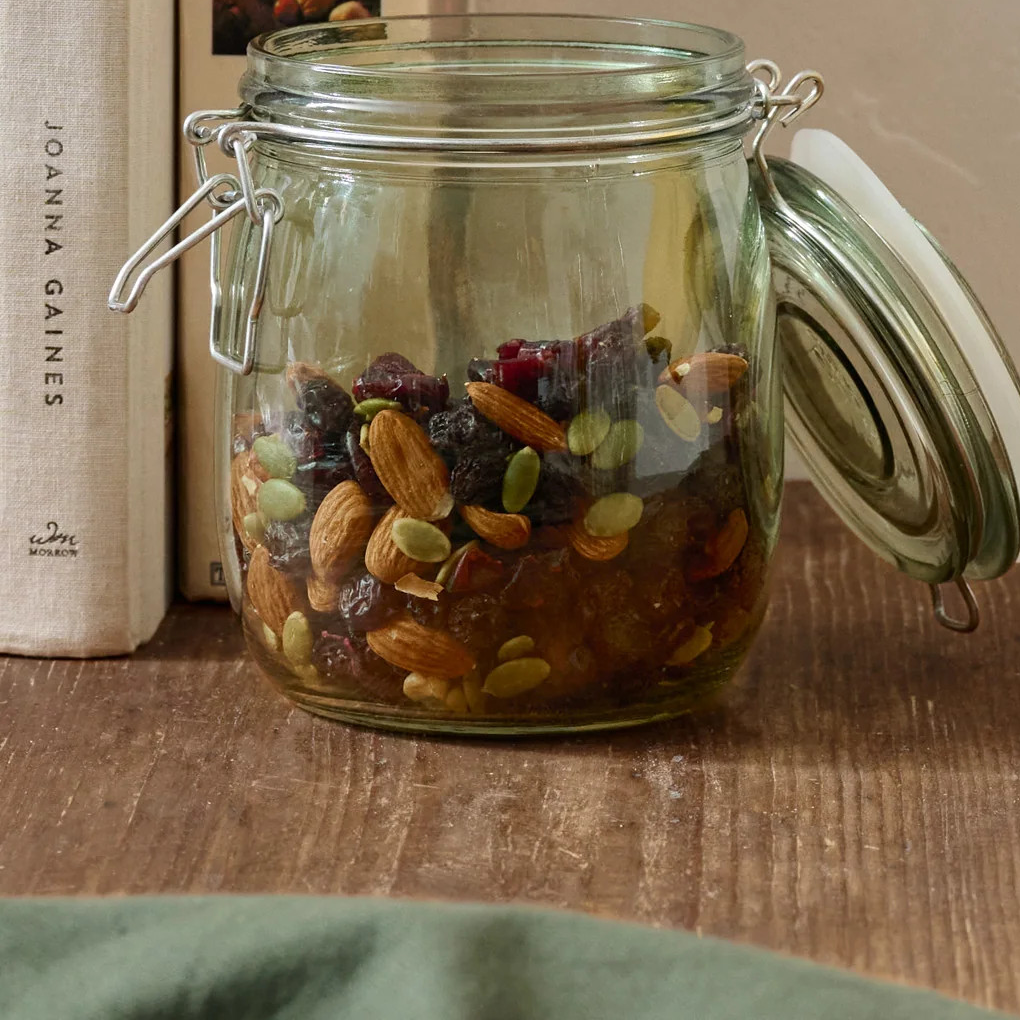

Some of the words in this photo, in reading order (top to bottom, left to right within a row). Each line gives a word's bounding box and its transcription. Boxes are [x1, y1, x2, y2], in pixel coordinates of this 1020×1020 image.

[45, 121, 64, 256] JOANNA
[45, 279, 64, 407] GAINES
[28, 547, 78, 558] MORROW
